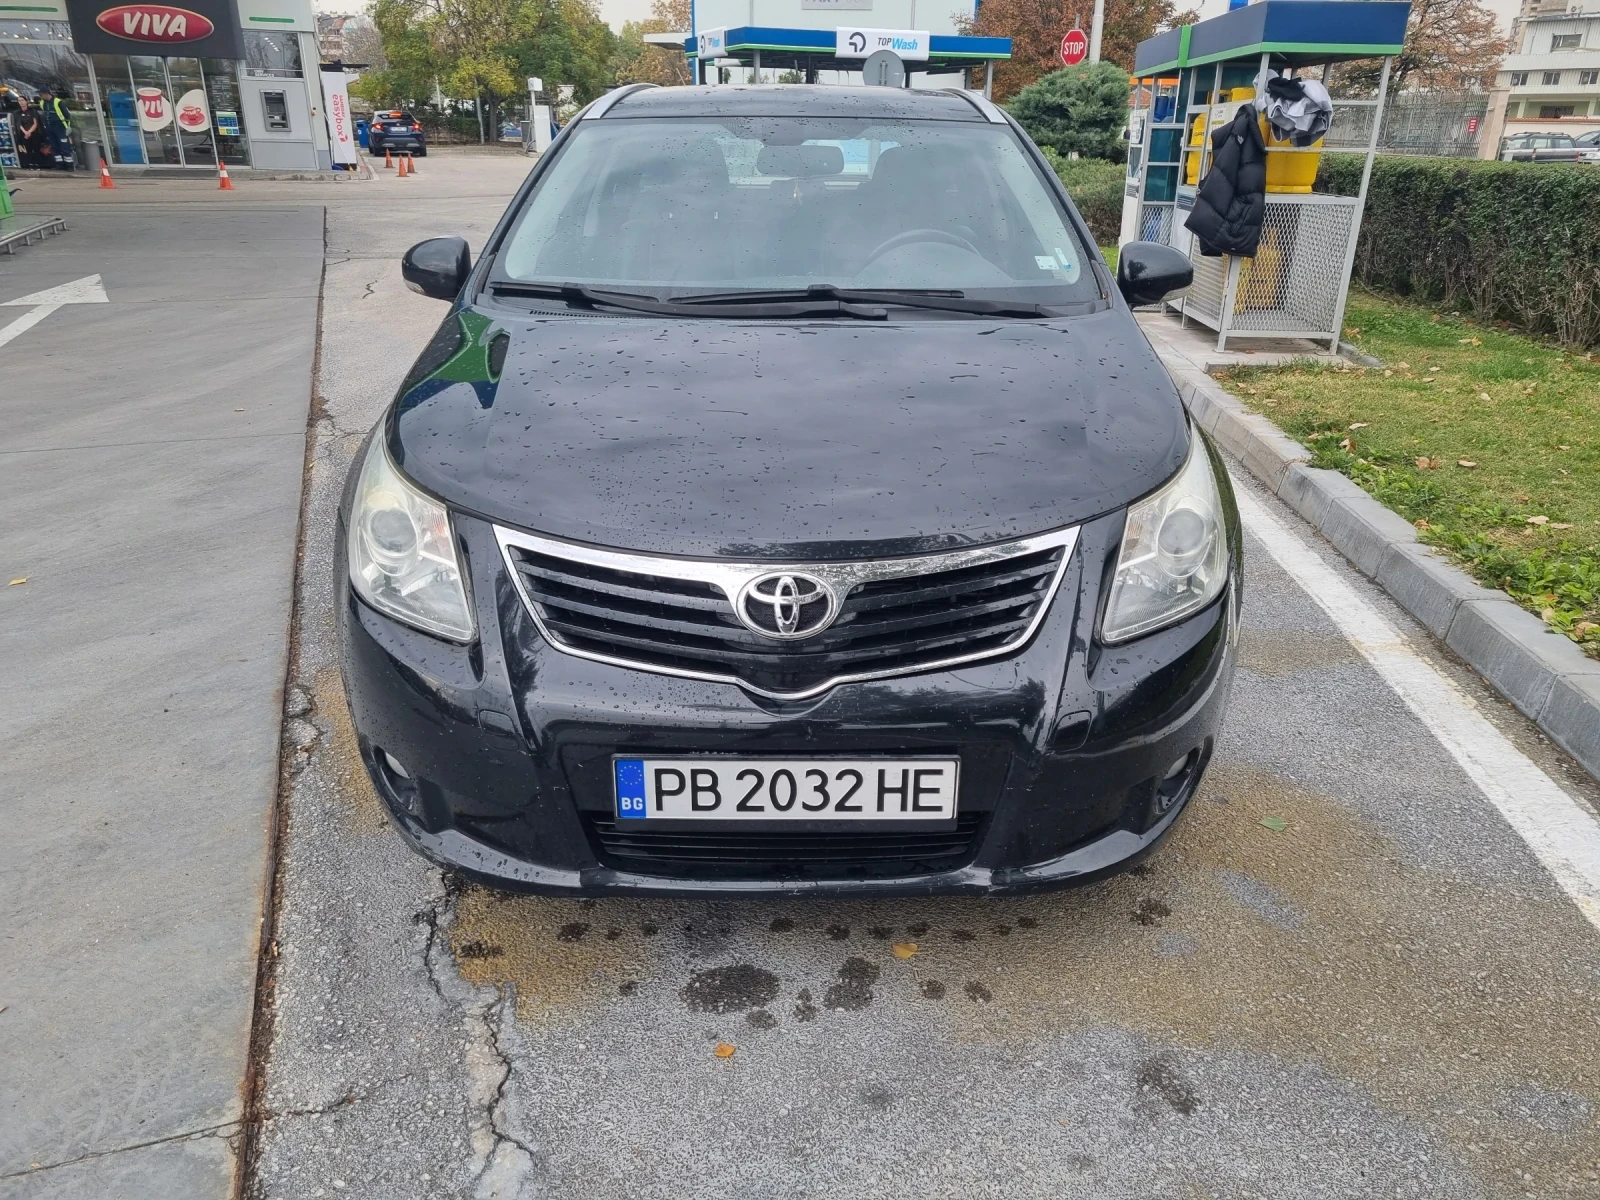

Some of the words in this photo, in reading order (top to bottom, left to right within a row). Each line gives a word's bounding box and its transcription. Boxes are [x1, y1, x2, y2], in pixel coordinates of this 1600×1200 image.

[123, 11, 187, 38] VIVA
[1064, 42, 1084, 54] STOP
[332, 94, 343, 136] easybox
[654, 768, 722, 812] PB
[736, 768, 864, 812] 2032
[876, 768, 944, 812] HE
[621, 797, 644, 811] BG
